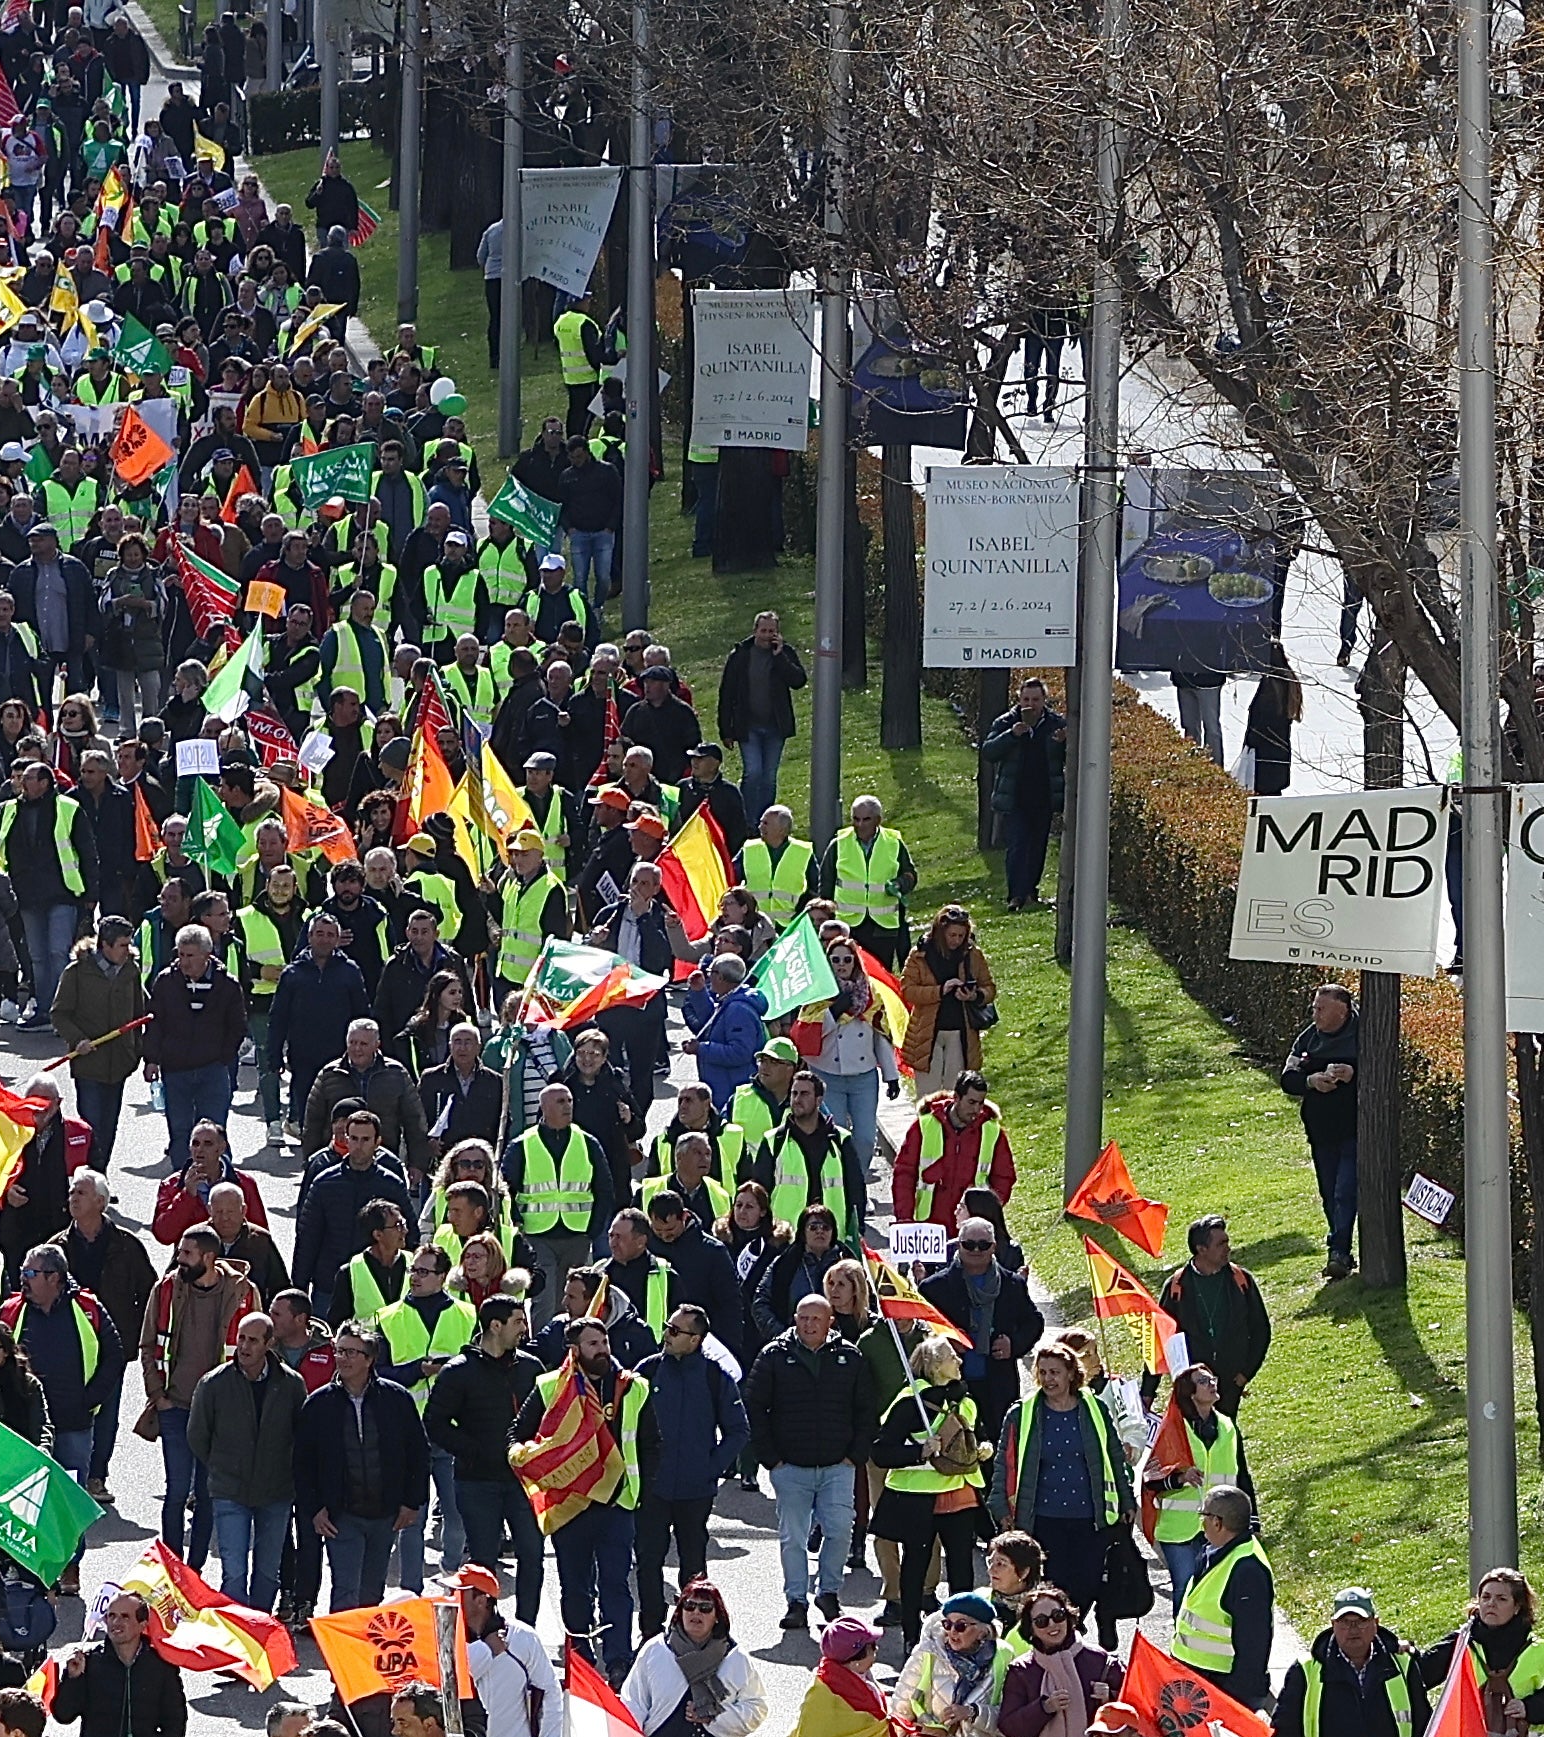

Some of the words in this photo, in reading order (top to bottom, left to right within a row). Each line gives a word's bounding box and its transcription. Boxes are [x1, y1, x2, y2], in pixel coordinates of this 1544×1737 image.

[727, 343, 781, 356] ISABEL
[699, 361, 806, 377] QUINTANILLA
[712, 393, 733, 403] 27.2
[746, 391, 794, 406] 2.6.2024
[738, 431, 782, 442] MADRID
[946, 479, 990, 491] MUSEO
[992, 479, 1058, 491] NACIONAL
[933, 493, 1070, 506] THYSSEN-BORNEMISZA
[969, 535, 1035, 552] ISABEL
[931, 558, 1070, 577] QUINTANILLA
[949, 600, 976, 615] 27.2
[991, 599, 1052, 615] 2.6.2024
[981, 647, 1037, 660] MADRID
[1255, 805, 1438, 854] MAD
[1317, 854, 1434, 900] RID
[1246, 898, 1336, 940] ES
[1311, 948, 1384, 965] MADRID
[892, 1229, 944, 1255] Justicia!
[375, 1650, 418, 1677] UPA
